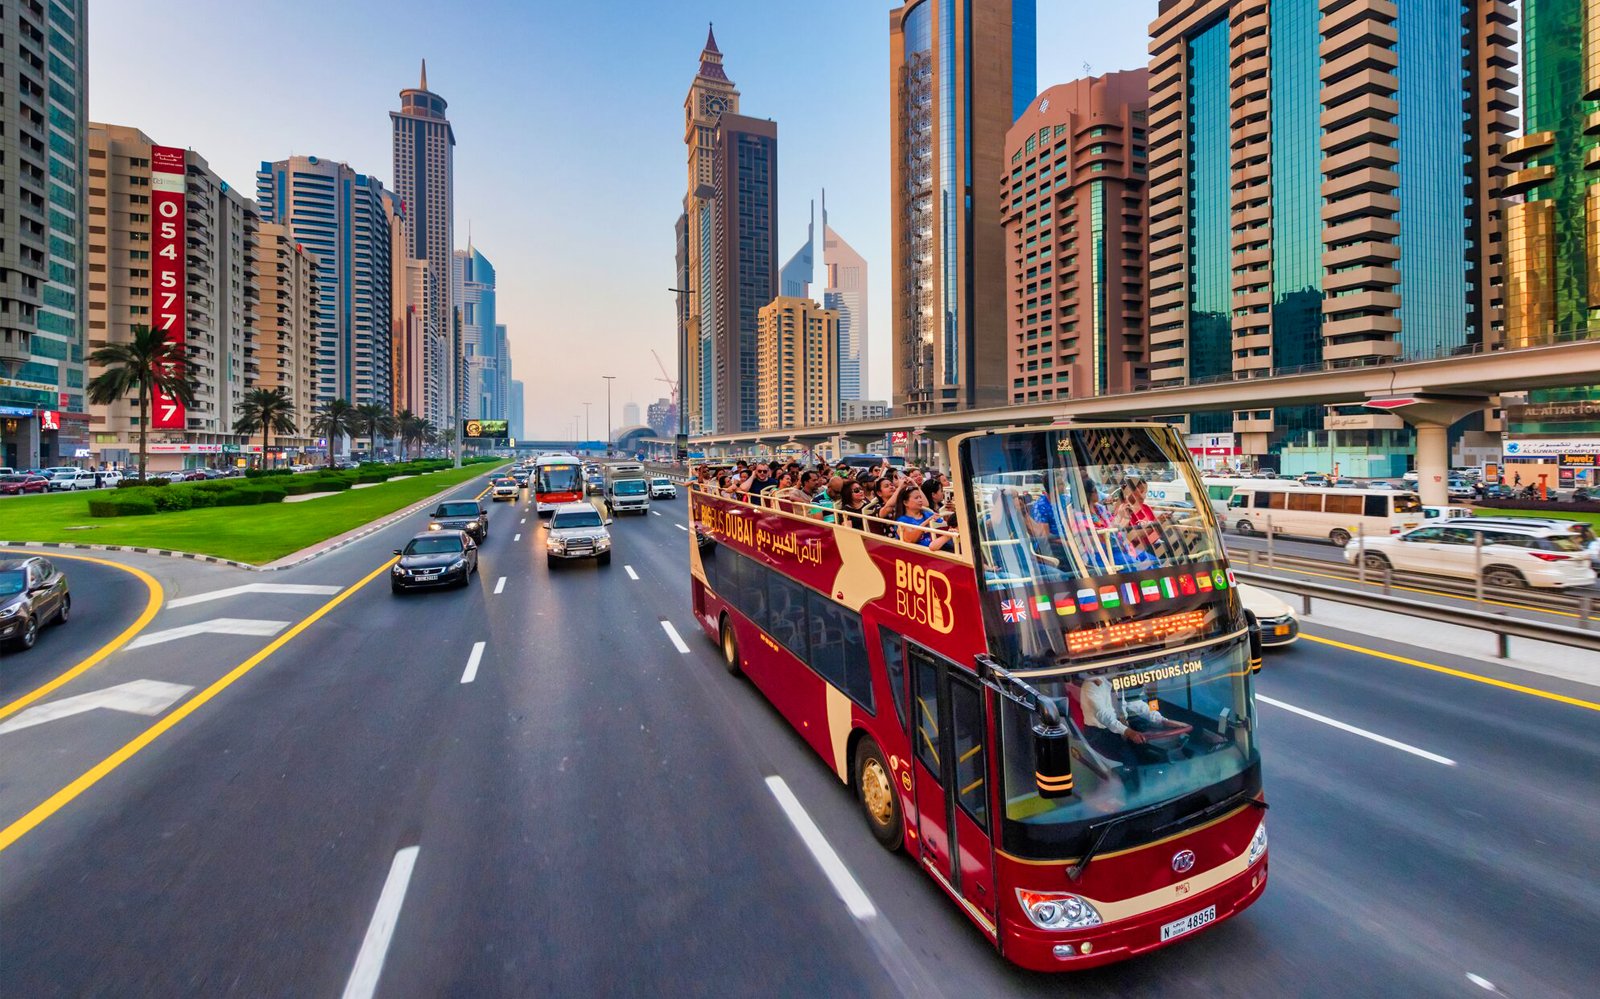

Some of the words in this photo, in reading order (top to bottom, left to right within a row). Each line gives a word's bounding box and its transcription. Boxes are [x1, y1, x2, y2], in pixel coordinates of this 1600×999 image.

[1524, 408, 1539, 416] AL
[1541, 406, 1575, 416] ATTAR
[74, 448, 90, 457] KFC
[726, 512, 753, 547] DUBAI
[756, 528, 771, 552] دبي
[772, 531, 798, 556] الكبير
[797, 537, 822, 567] الباص
[895, 558, 926, 595] BIG
[896, 588, 927, 625] BUS
[1112, 660, 1203, 690] BIGBUSTOURS.COM
[1164, 926, 1170, 939] N
[1187, 908, 1215, 929] 48956
